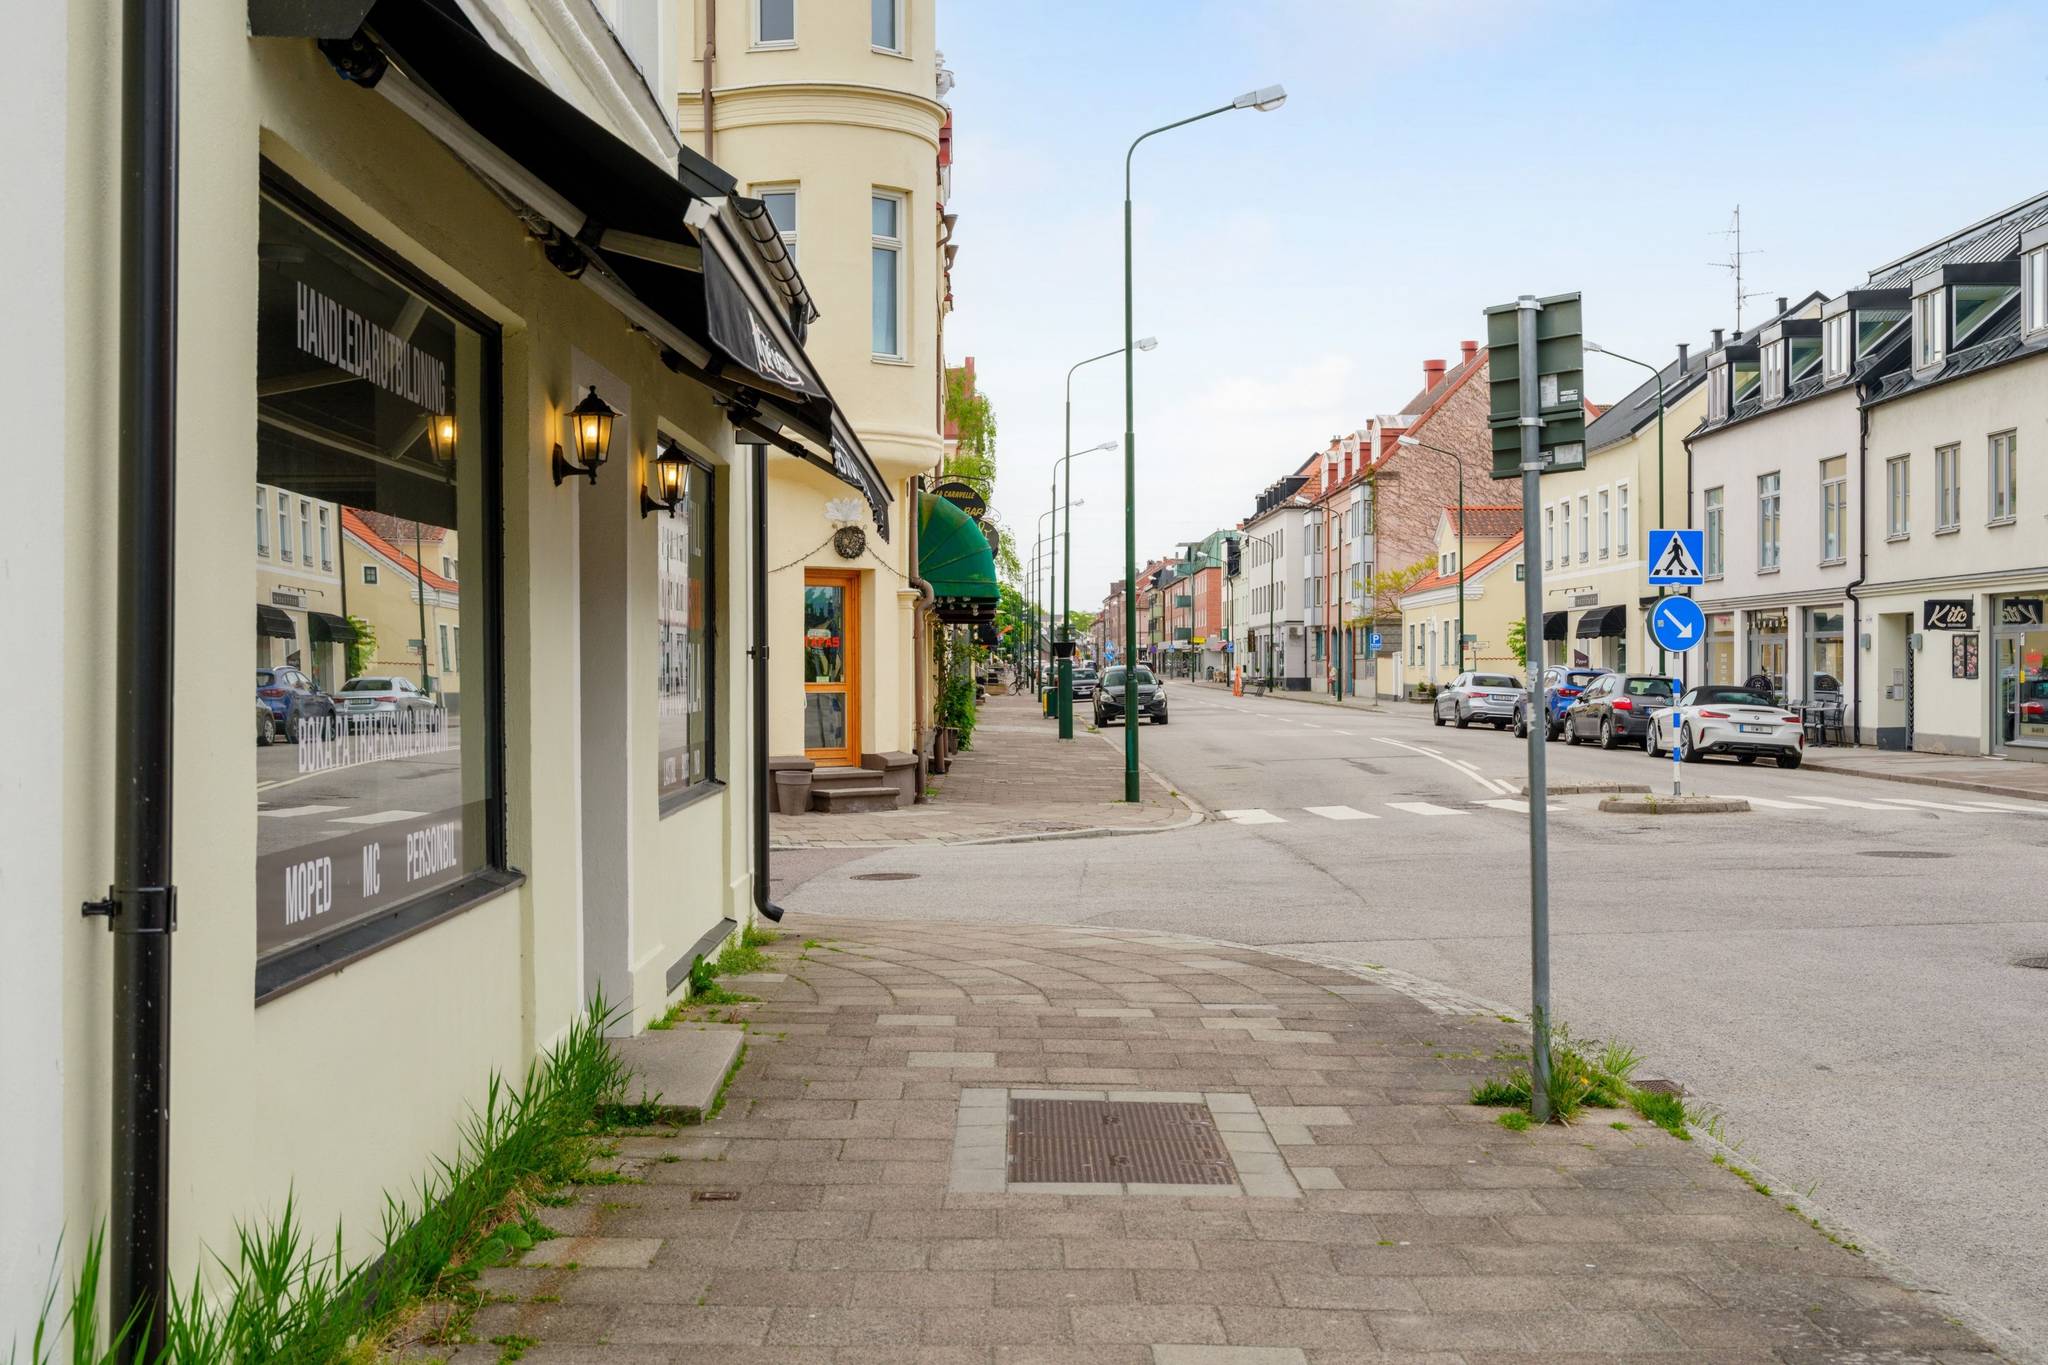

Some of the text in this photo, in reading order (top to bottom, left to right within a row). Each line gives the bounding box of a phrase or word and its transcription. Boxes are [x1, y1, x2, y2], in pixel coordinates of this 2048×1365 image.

[297, 281, 446, 415] HANDLEDARUTBILDNING
[963, 506, 984, 516] BAR
[1928, 604, 1968, 627] Kito
[804, 636, 841, 648] TAPAS
[299, 715, 333, 774] BOKA
[285, 821, 457, 926] MOPED MC PERSONBIL
